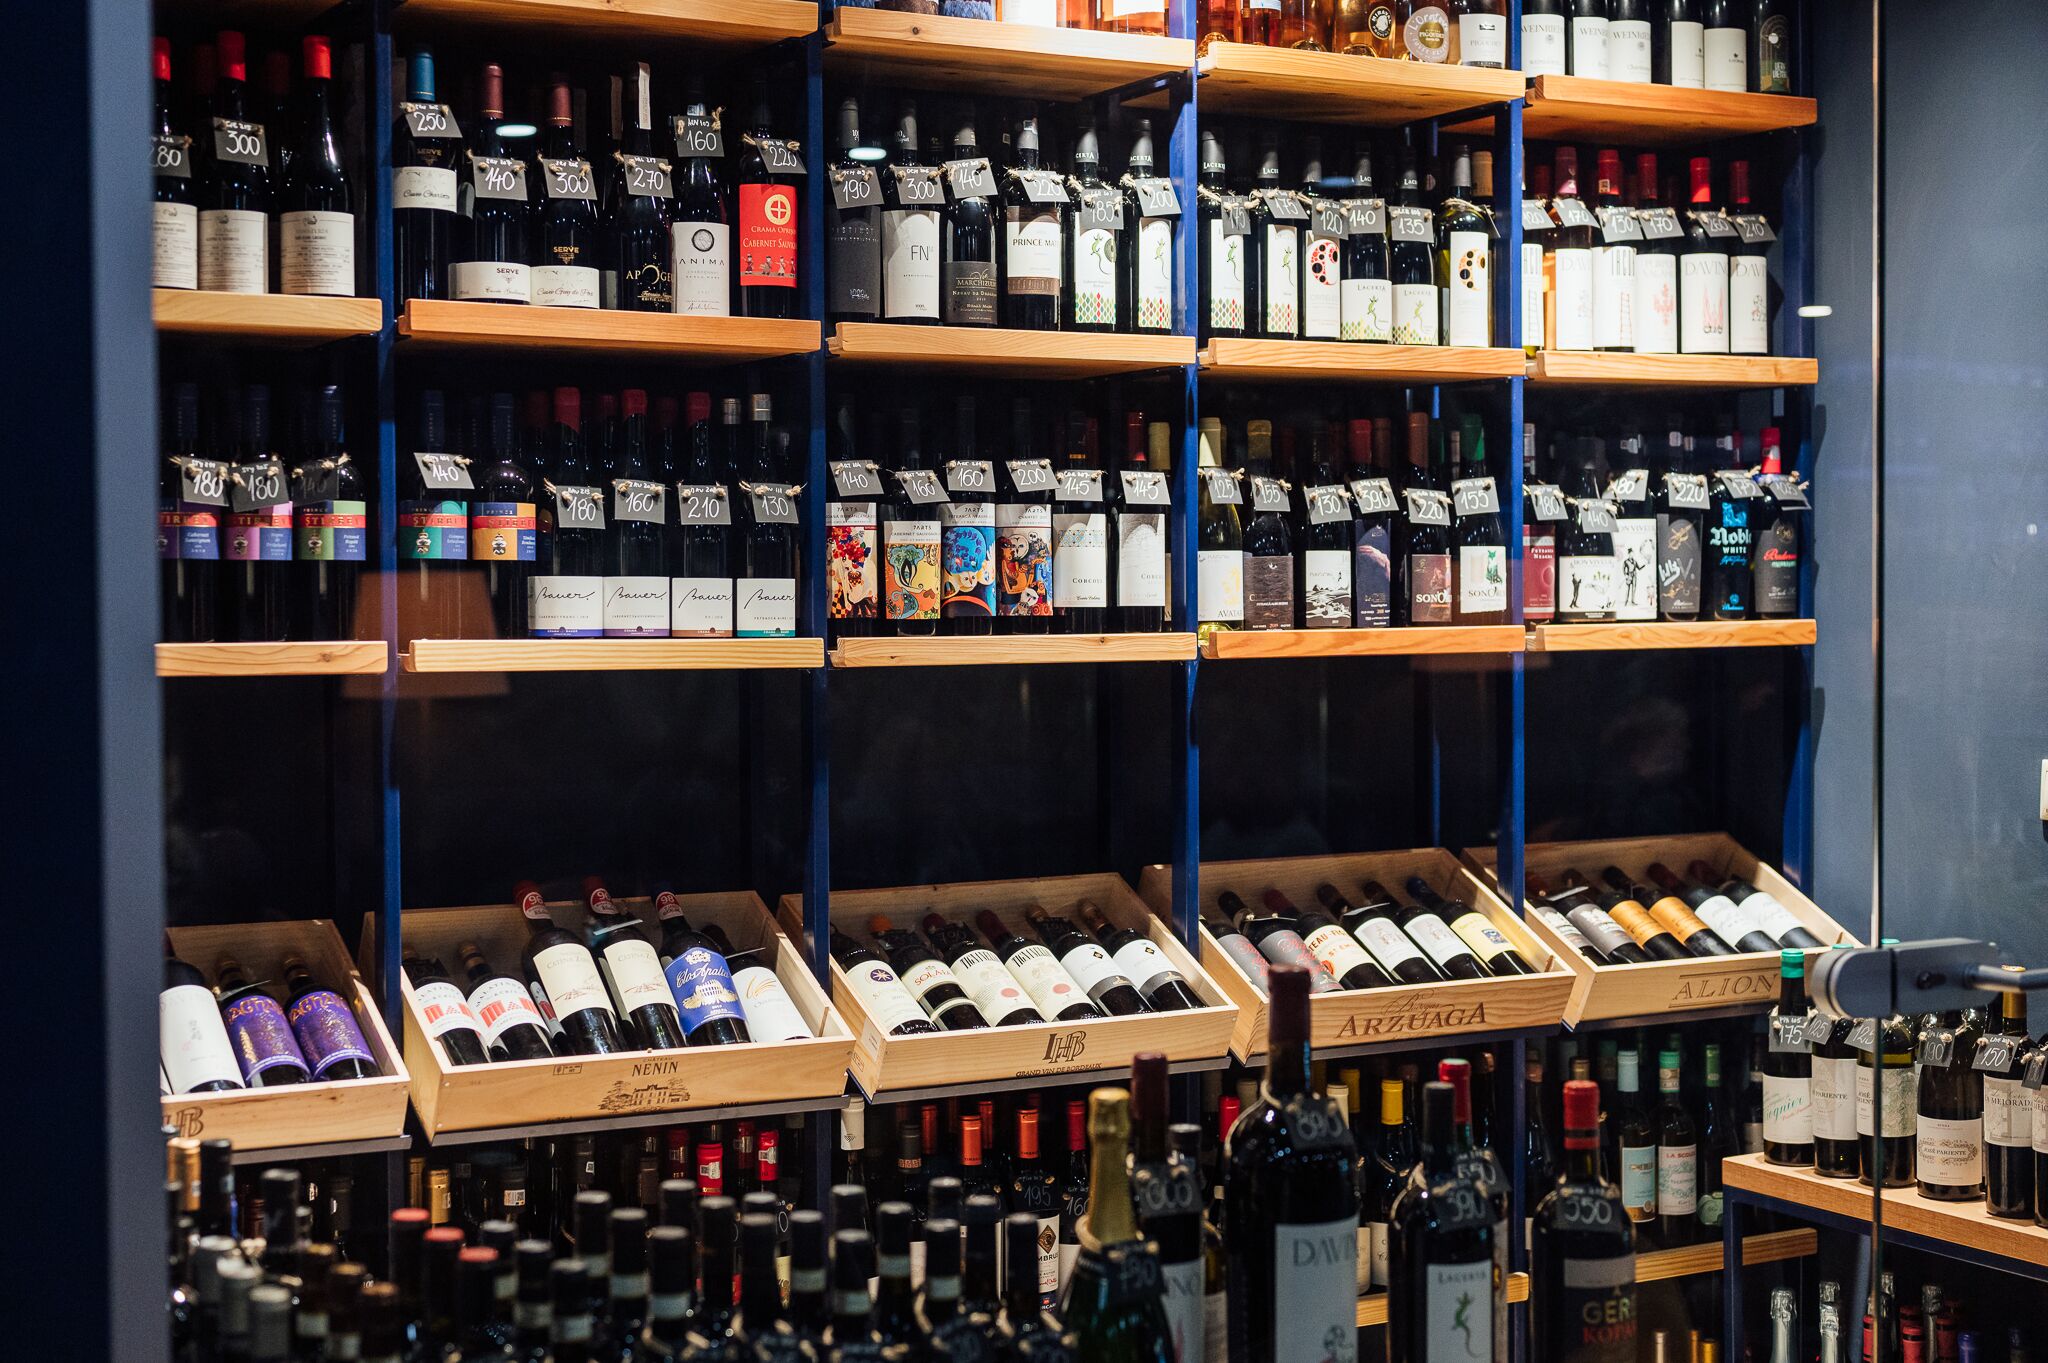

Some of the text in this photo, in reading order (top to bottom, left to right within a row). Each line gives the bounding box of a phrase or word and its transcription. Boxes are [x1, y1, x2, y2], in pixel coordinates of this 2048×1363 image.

[414, 112, 447, 131] 250
[226, 130, 261, 156] 300
[687, 130, 718, 151] 160
[769, 146, 798, 167] 220
[485, 167, 516, 192] 140
[556, 172, 589, 194] 300
[633, 167, 665, 192] 270
[958, 168, 982, 190] 140
[1034, 179, 1062, 197] 220
[842, 179, 871, 202] 190
[907, 178, 935, 200] 300
[1150, 190, 1173, 209] 200
[1274, 196, 1299, 215] 175
[1092, 200, 1115, 222] 185
[1230, 205, 1246, 229] 175
[1349, 209, 1376, 226] 140
[1567, 209, 1590, 223] 170
[751, 225, 776, 234] CRAMA
[1320, 210, 1343, 234] 120
[1399, 216, 1425, 236] 135
[1649, 215, 1673, 233] 170
[1709, 217, 1730, 232] 260
[1745, 222, 1765, 237] 210
[553, 246, 579, 254] SERVE
[743, 237, 776, 249] CABERNET
[1012, 238, 1044, 247] PRINCE
[679, 258, 726, 266] ANIMA
[910, 245, 930, 261] FN
[496, 267, 519, 275] SERVE
[1357, 283, 1386, 292] LACERTA
[432, 463, 460, 482] 140
[842, 470, 869, 489] 140
[957, 468, 984, 487] 160
[1018, 467, 1046, 486] 200
[193, 470, 224, 498] 180
[248, 474, 280, 502] 180
[912, 480, 936, 497] 160
[1064, 478, 1091, 496] 145
[1133, 480, 1159, 500] 145
[1215, 479, 1234, 499] 125
[1674, 481, 1705, 502] 220
[1733, 477, 1756, 496] 175
[625, 491, 655, 513] 160
[1260, 484, 1281, 504] 155
[1460, 490, 1489, 510] 155
[567, 496, 597, 521] 180
[687, 496, 721, 519] 210
[761, 496, 790, 517] 130
[1317, 494, 1342, 516] 130
[1417, 500, 1443, 519] 220
[1539, 493, 1559, 516] 180
[1587, 510, 1609, 528] 140
[1722, 546, 1747, 554] WHITE
[660, 895, 674, 904] 98
[1672, 972, 1780, 1000] ALION
[1335, 1001, 1487, 1039] ARZUAGA
[1779, 1025, 1803, 1046] 175
[1807, 1021, 1828, 1039] 125
[1924, 1042, 1946, 1061] 190
[1979, 1048, 2006, 1067] 150
[631, 1060, 680, 1078] NENIN
[1015, 1062, 1103, 1078] GRAND VIN DE BORDEAUX
[1937, 1147, 1968, 1156] PARIENTE
[1023, 1184, 1051, 1208] 195
